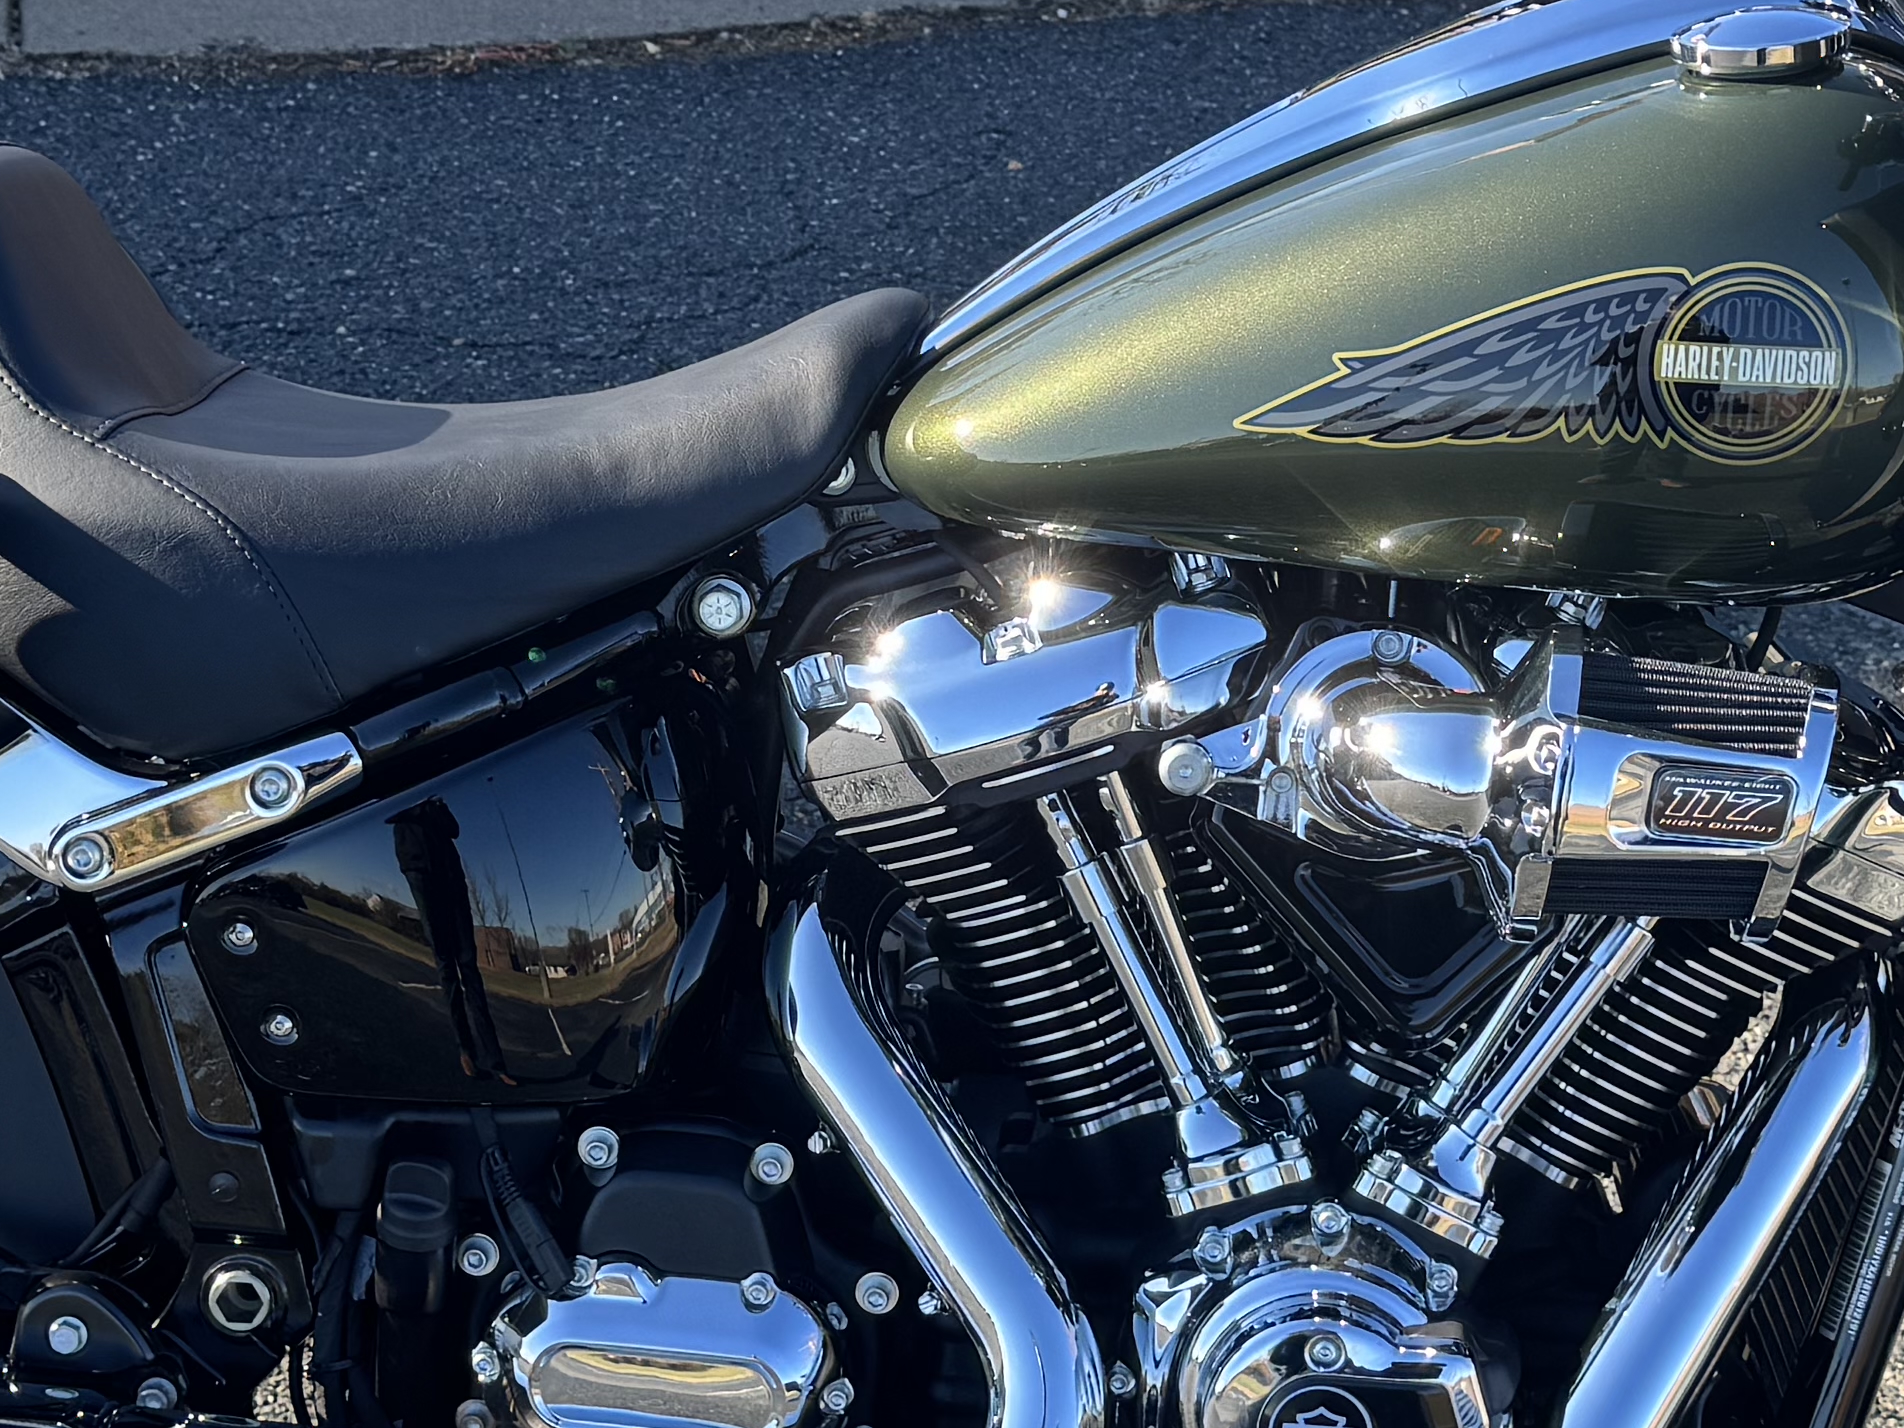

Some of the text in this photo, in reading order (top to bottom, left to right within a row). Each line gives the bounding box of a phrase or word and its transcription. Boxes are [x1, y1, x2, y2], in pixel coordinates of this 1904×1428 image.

[1698, 297, 1804, 340] MOTOR
[1660, 342, 1838, 385] HARLEY-DAVIDSON
[1691, 389, 1799, 432] CYCLES
[1664, 786, 1784, 821] 117
[1659, 818, 1777, 833] HIGH OUTPUT
